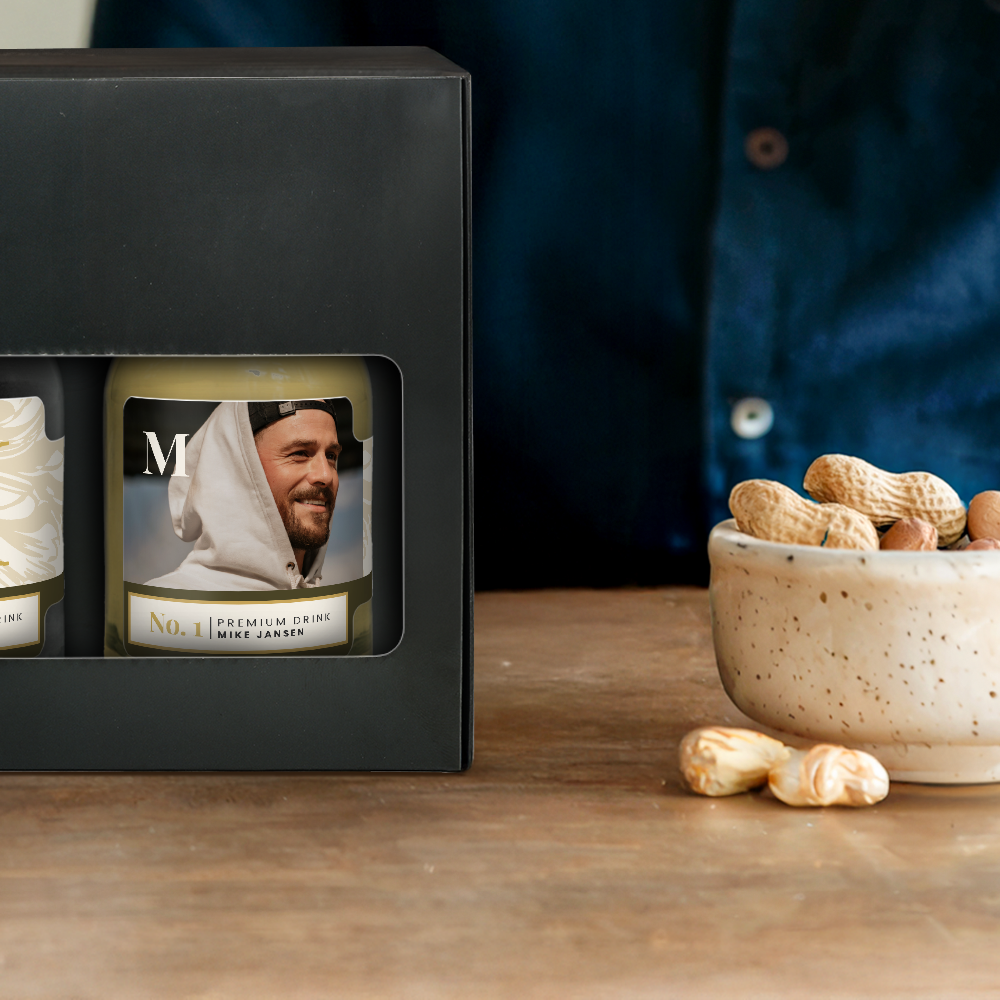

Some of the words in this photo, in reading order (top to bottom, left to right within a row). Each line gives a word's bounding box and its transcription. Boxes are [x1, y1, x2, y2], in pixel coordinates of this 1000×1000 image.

[142, 430, 190, 478] M
[149, 611, 186, 637] No.
[193, 621, 203, 637] 1
[217, 617, 286, 627] PREMIUM
[293, 612, 331, 625] DRINK
[217, 630, 250, 639] MIKE
[256, 628, 304, 639] JANSEN
